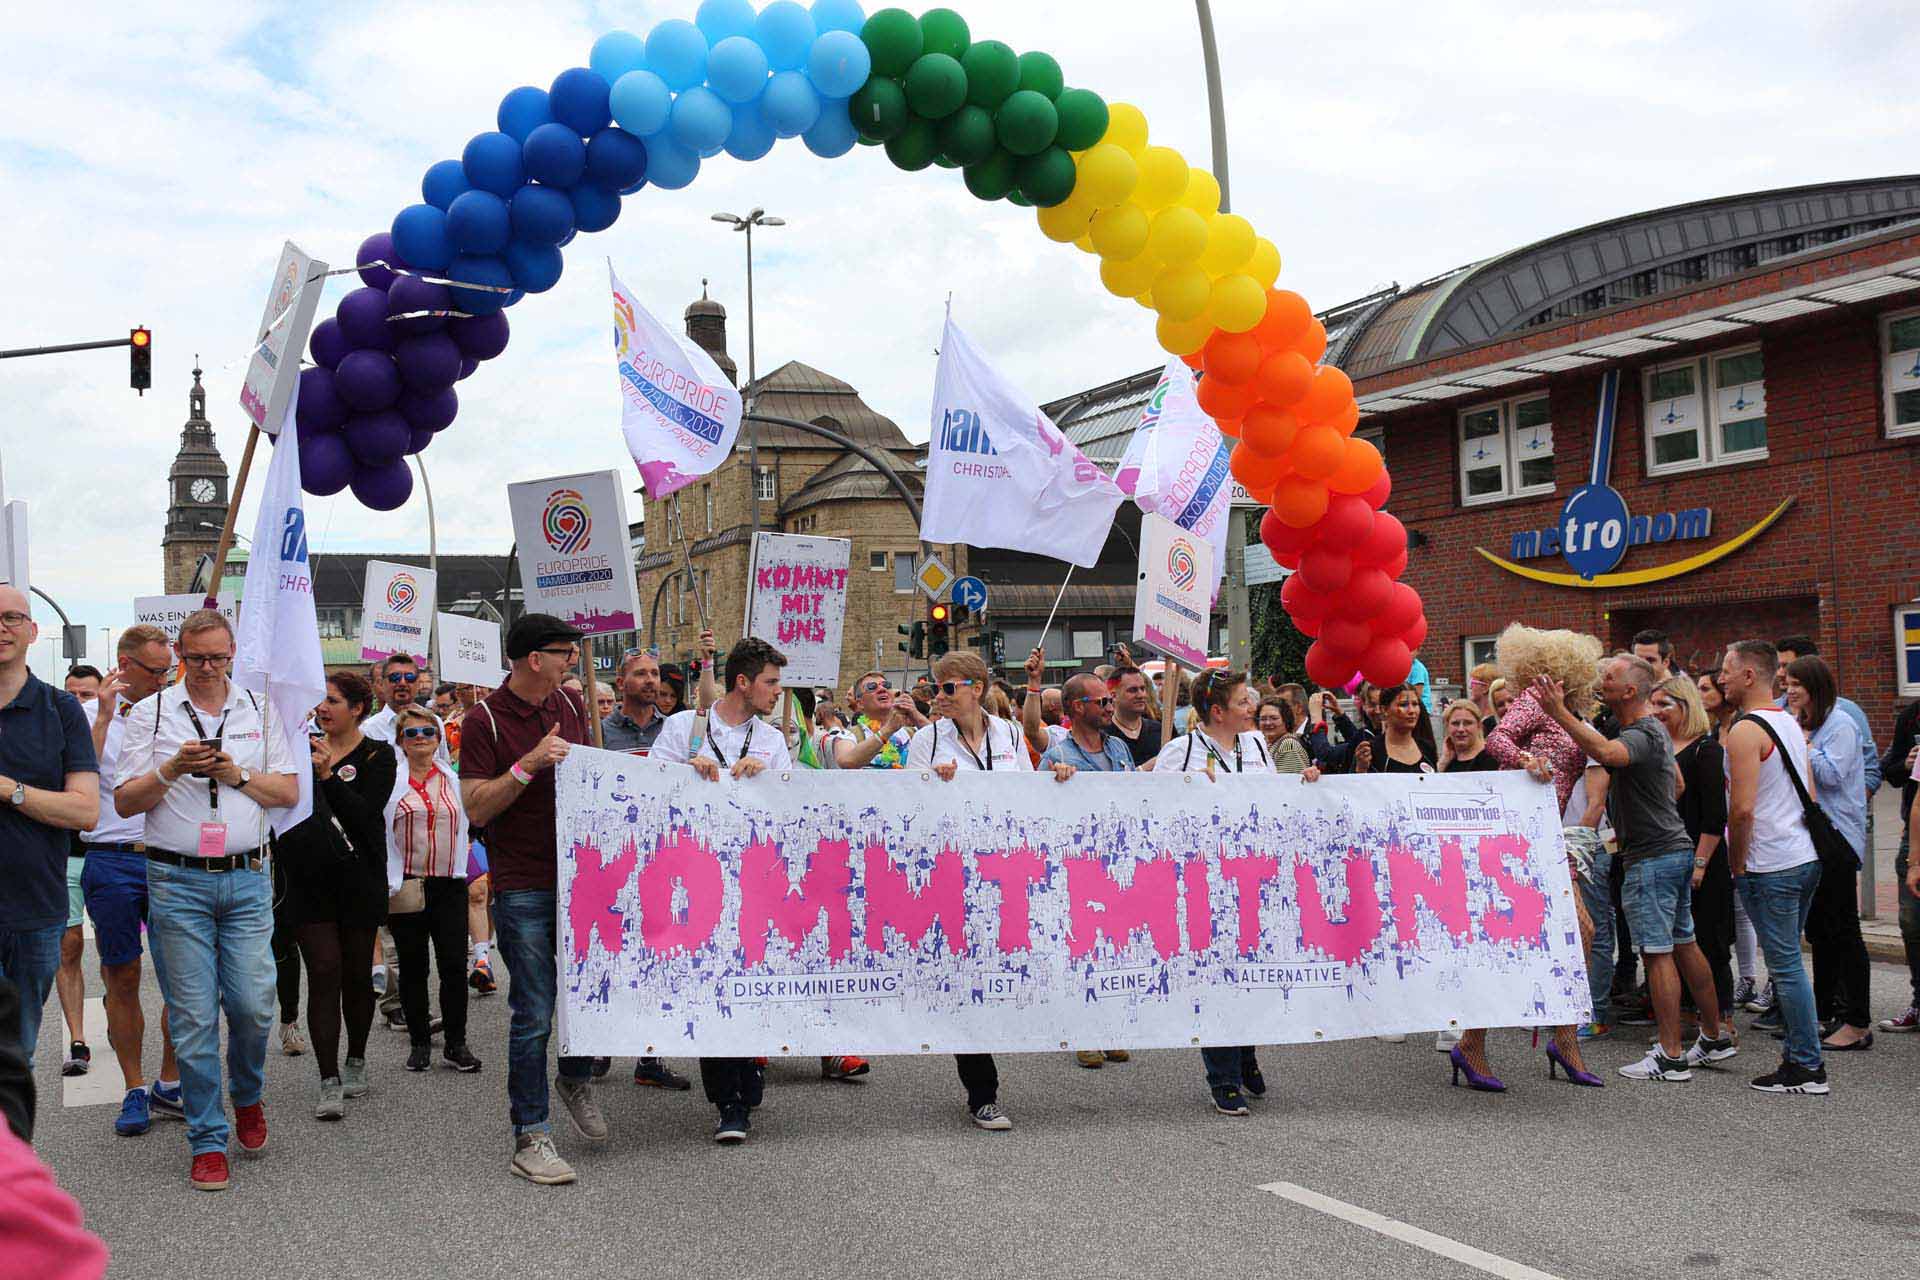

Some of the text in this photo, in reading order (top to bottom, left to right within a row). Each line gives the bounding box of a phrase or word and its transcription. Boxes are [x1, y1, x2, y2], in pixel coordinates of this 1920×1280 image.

[632, 351, 728, 420] EUROPRIDE
[622, 364, 721, 442] HAMBURG 2020
[672, 427, 714, 458] PRIDE
[1510, 507, 1712, 559] metronom
[537, 554, 610, 575] EUROPRIDE
[758, 564, 848, 592] KOMMT
[538, 569, 611, 588] HAMBURG 2020
[586, 581, 614, 593] PRIDE
[138, 612, 164, 623] WAS
[167, 610, 186, 621] EIN
[781, 594, 824, 615] MIT
[778, 618, 826, 644] UNS
[1415, 806, 1500, 821] hamburgpride
[568, 824, 1546, 968] KOMMT MIT UNS
[734, 967, 1342, 997] DISKRIMINIERUNG IST KEINE ALTERNATIVE
